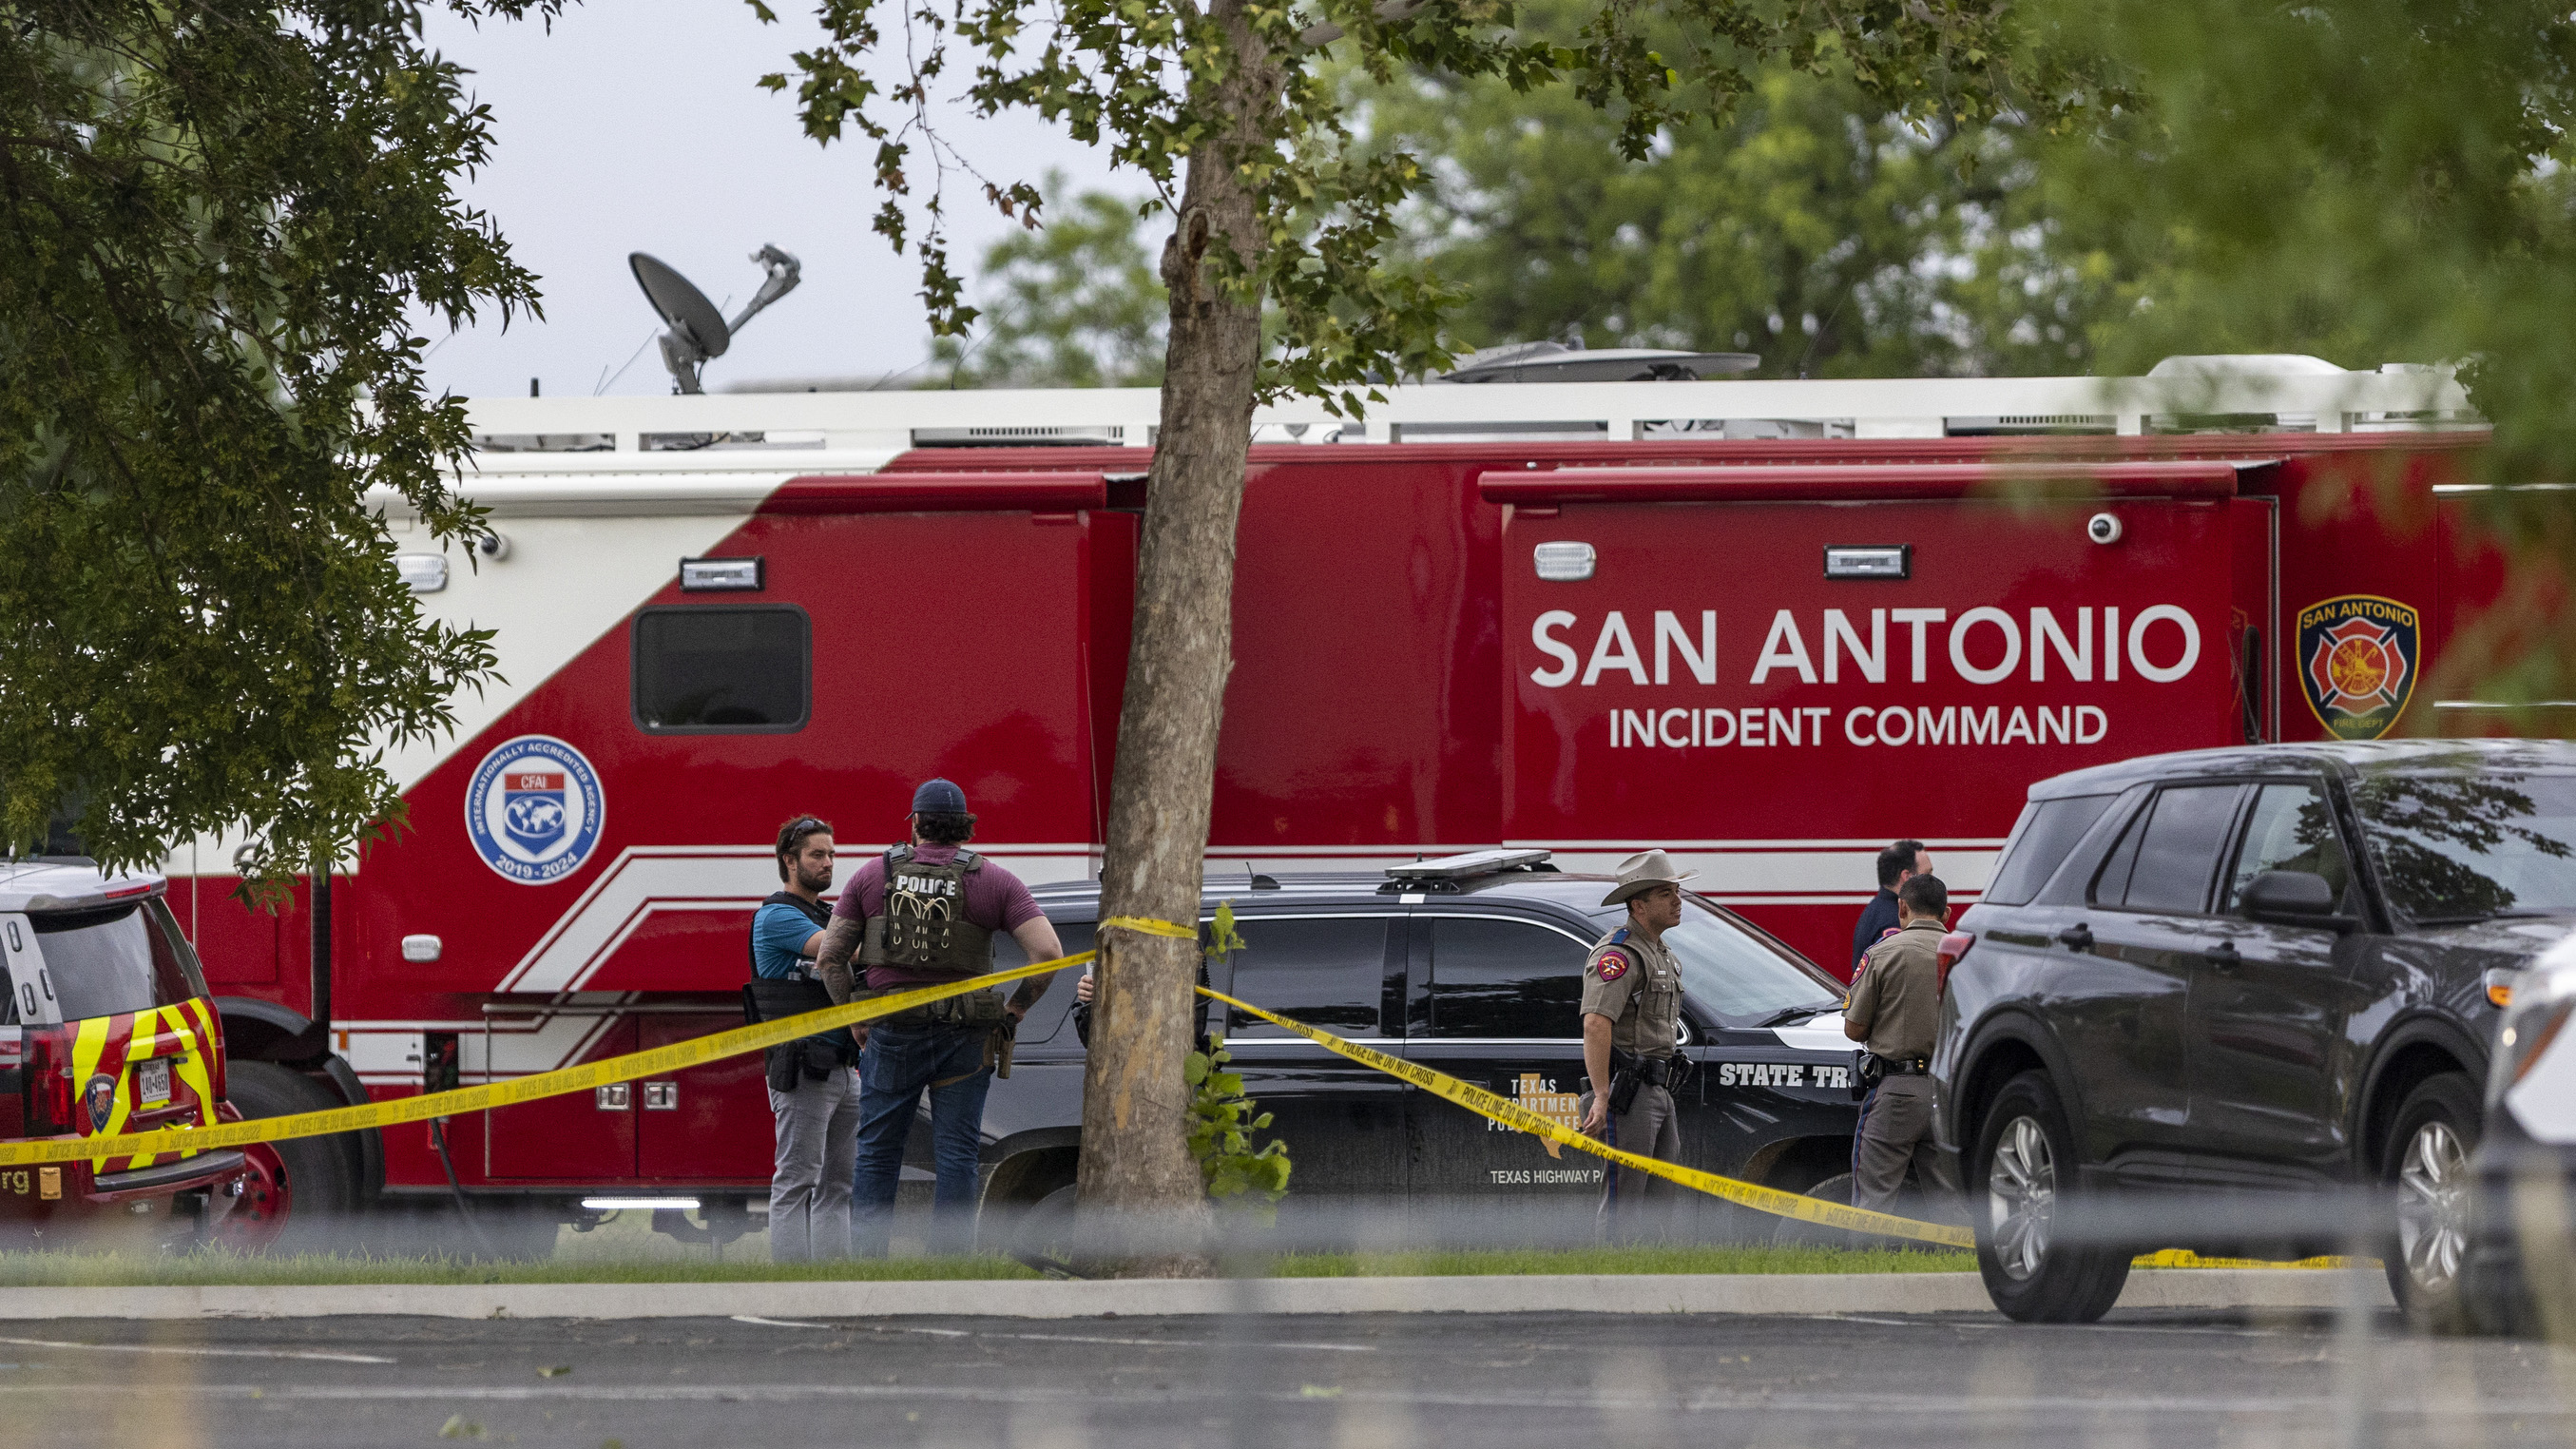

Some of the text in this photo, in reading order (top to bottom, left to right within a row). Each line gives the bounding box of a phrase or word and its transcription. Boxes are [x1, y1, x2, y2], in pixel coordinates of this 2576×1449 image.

[2302, 601, 2413, 629] SAN ANTONIO
[1531, 605, 2200, 686] SAN ANTONIO
[1610, 705, 2106, 747] INCIDENT COMMAND
[473, 744, 597, 835] INTERNATIONALLY ACCREDITED AGENCY
[521, 775, 548, 789] CFAI
[895, 875, 956, 897] POLICE
[1340, 1040, 1436, 1086] POLICE LINE DO NOT CROSS
[1720, 1063, 1803, 1087] STATE
[1510, 1078, 1557, 1094] TEXAS
[1460, 1086, 1489, 1110] POLICE
[1486, 1097, 1505, 1117] LINE
[1502, 1104, 1515, 1121] DO
[1513, 1109, 1531, 1128] NOT
[1528, 1116, 1555, 1138] CROSS
[1580, 1139, 1606, 1157] POLICE
[1490, 1170, 1530, 1184] TEXAS
[1533, 1169, 1590, 1184] HIGHWAY
